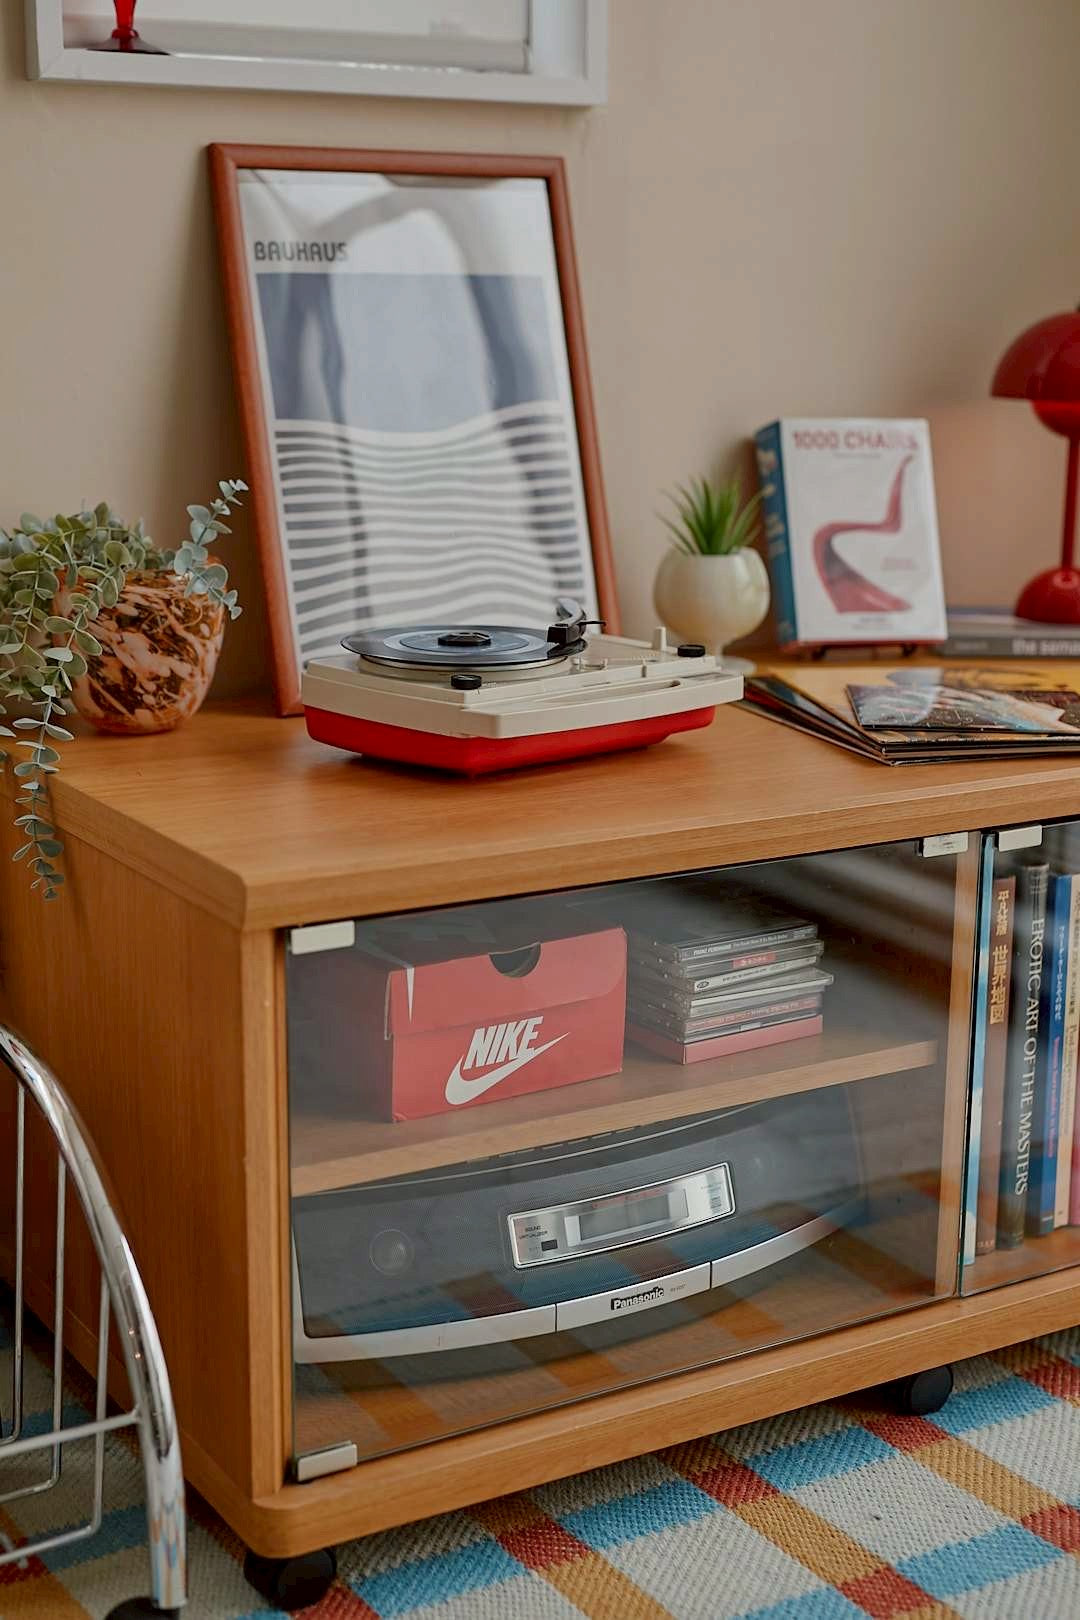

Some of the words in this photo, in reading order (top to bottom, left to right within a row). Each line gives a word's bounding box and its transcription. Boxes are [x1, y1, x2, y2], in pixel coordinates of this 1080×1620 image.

[254, 241, 348, 262] BAUHAUS
[792, 430, 839, 449] 1000
[1027, 919, 1045, 991] EROTIC
[1025, 996, 1040, 1032] ART
[463, 1015, 544, 1070] NIKE
[1023, 1037, 1037, 1065] OF
[1020, 1066, 1035, 1109] THE
[1015, 1111, 1033, 1195] MASTERS
[610, 1286, 665, 1310] Panasonic
